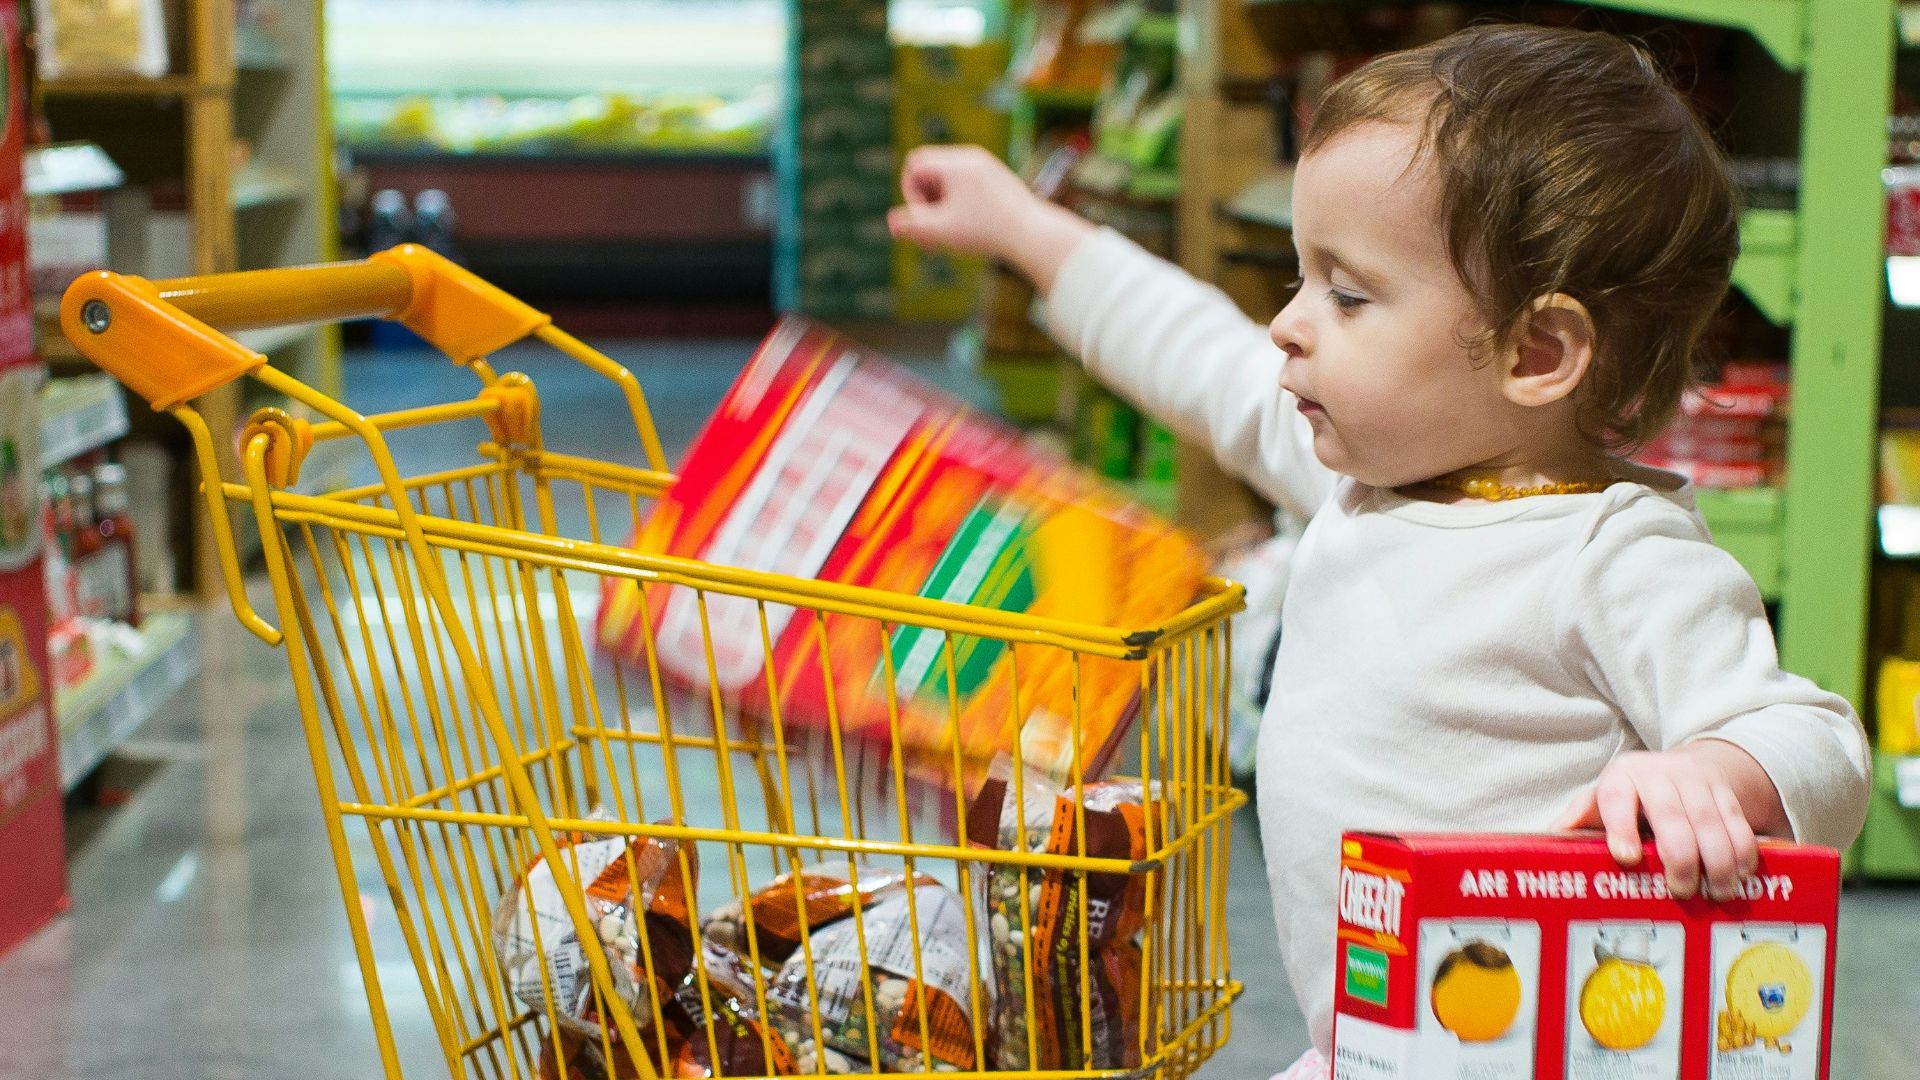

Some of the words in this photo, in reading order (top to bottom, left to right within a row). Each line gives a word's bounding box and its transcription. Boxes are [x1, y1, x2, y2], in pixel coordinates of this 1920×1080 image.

[1459, 869, 1508, 897] ARE
[1514, 869, 1587, 898] THESE
[1593, 871, 1676, 900] CHEES
